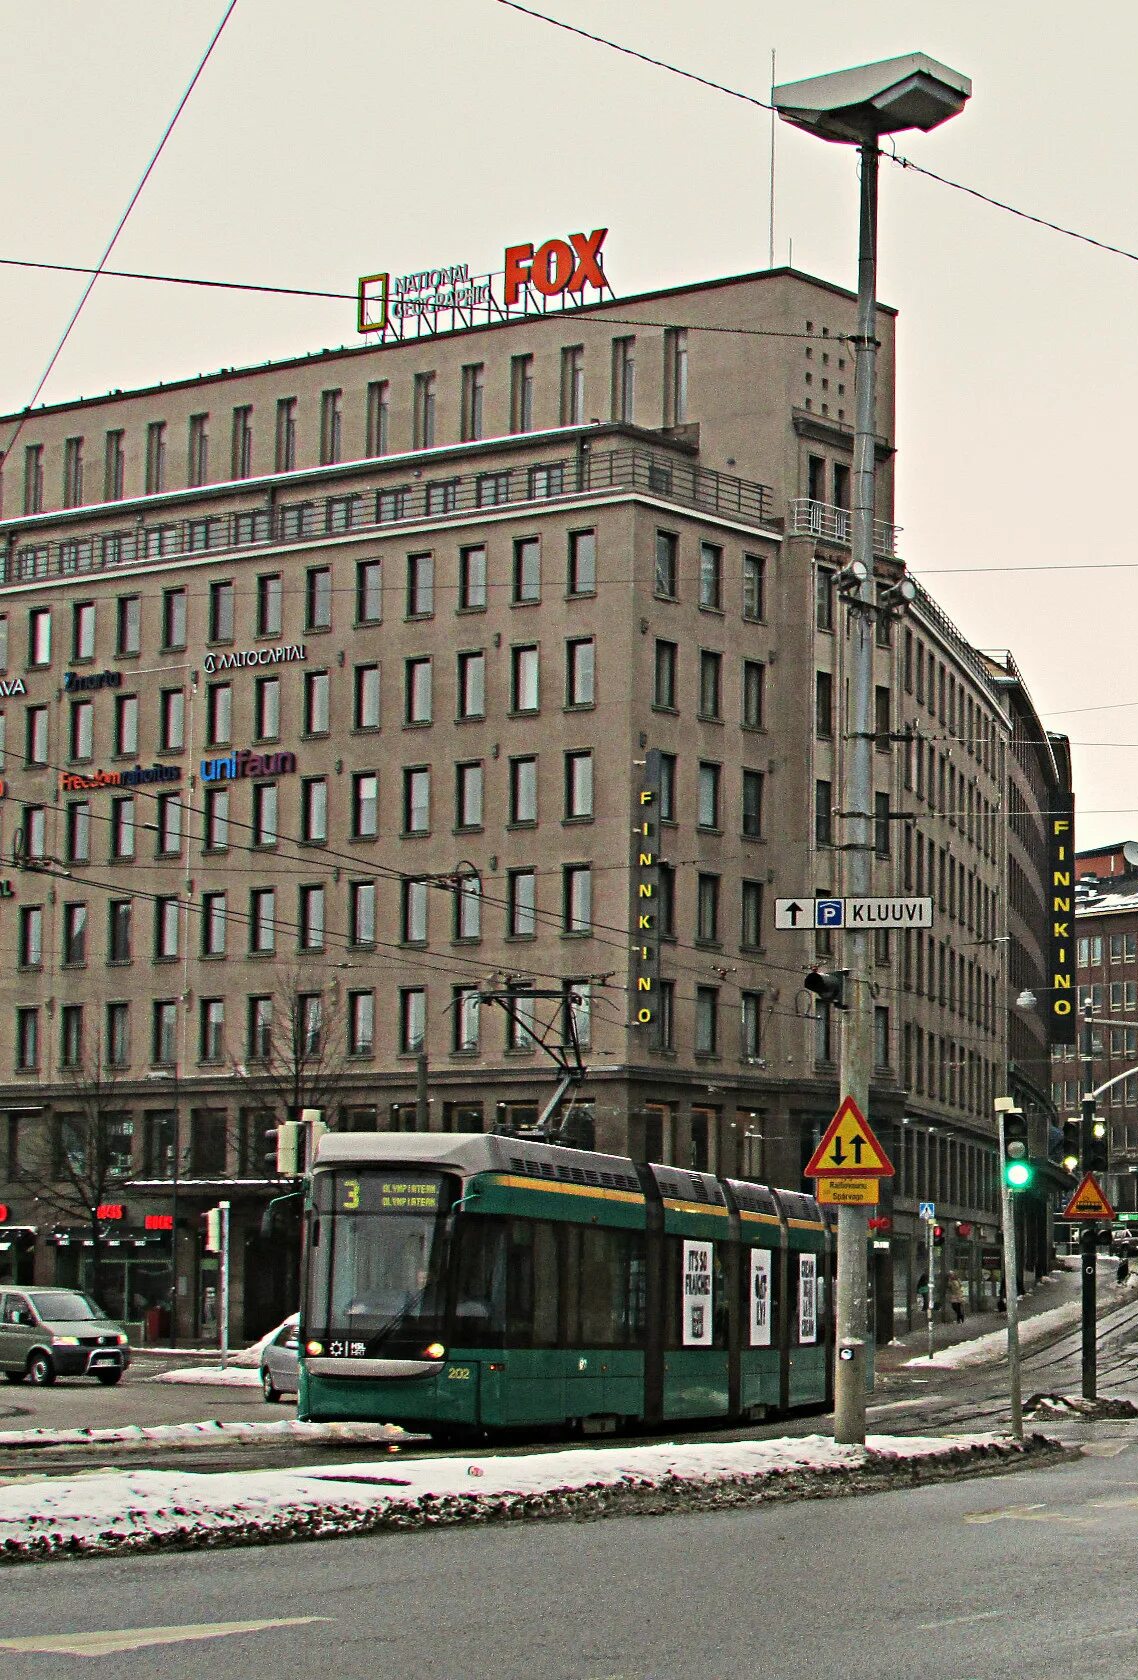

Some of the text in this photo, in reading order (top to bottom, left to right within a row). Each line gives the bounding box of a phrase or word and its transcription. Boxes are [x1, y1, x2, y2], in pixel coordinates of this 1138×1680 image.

[394, 263, 470, 295] NATIONAL
[504, 228, 608, 305] FOX
[392, 283, 493, 320] GEOGRAPHIC
[0, 678, 27, 697] VA
[200, 749, 297, 782] unifaun
[637, 790, 653, 1024] FINNKINO
[853, 903, 923, 922] KLUUVI
[1053, 819, 1072, 1016] FINNKINO
[342, 1178, 361, 1210] 3
[447, 1367, 471, 1380] 202
